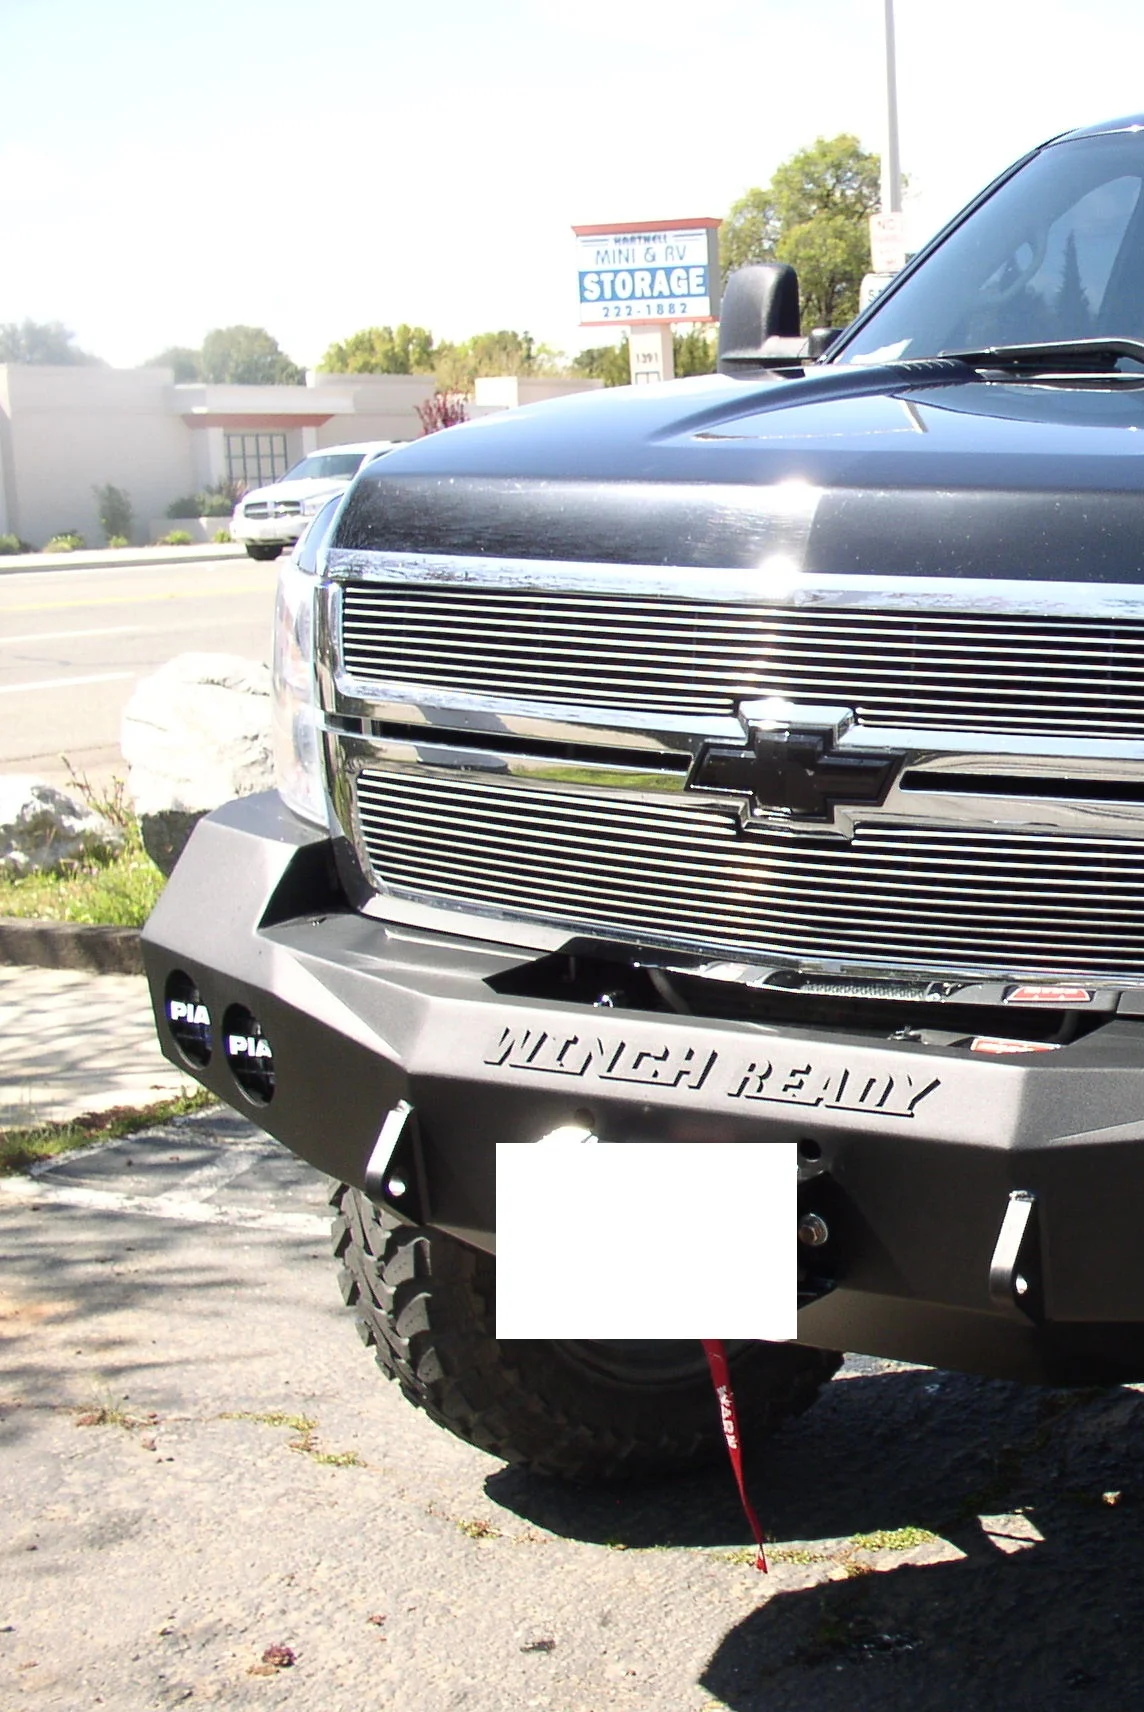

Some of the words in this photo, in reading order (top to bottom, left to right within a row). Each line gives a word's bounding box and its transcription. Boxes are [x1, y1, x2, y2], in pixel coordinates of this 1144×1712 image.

[595, 248, 636, 265] MINI
[644, 247, 656, 263] &
[664, 245, 687, 262] RV
[583, 267, 706, 301] STORAGE
[602, 302, 688, 318] 222-1882
[170, 1000, 212, 1026] PIA
[228, 1034, 273, 1058] PIA
[483, 1025, 720, 1091] WINCH
[726, 1058, 942, 1118] READY
